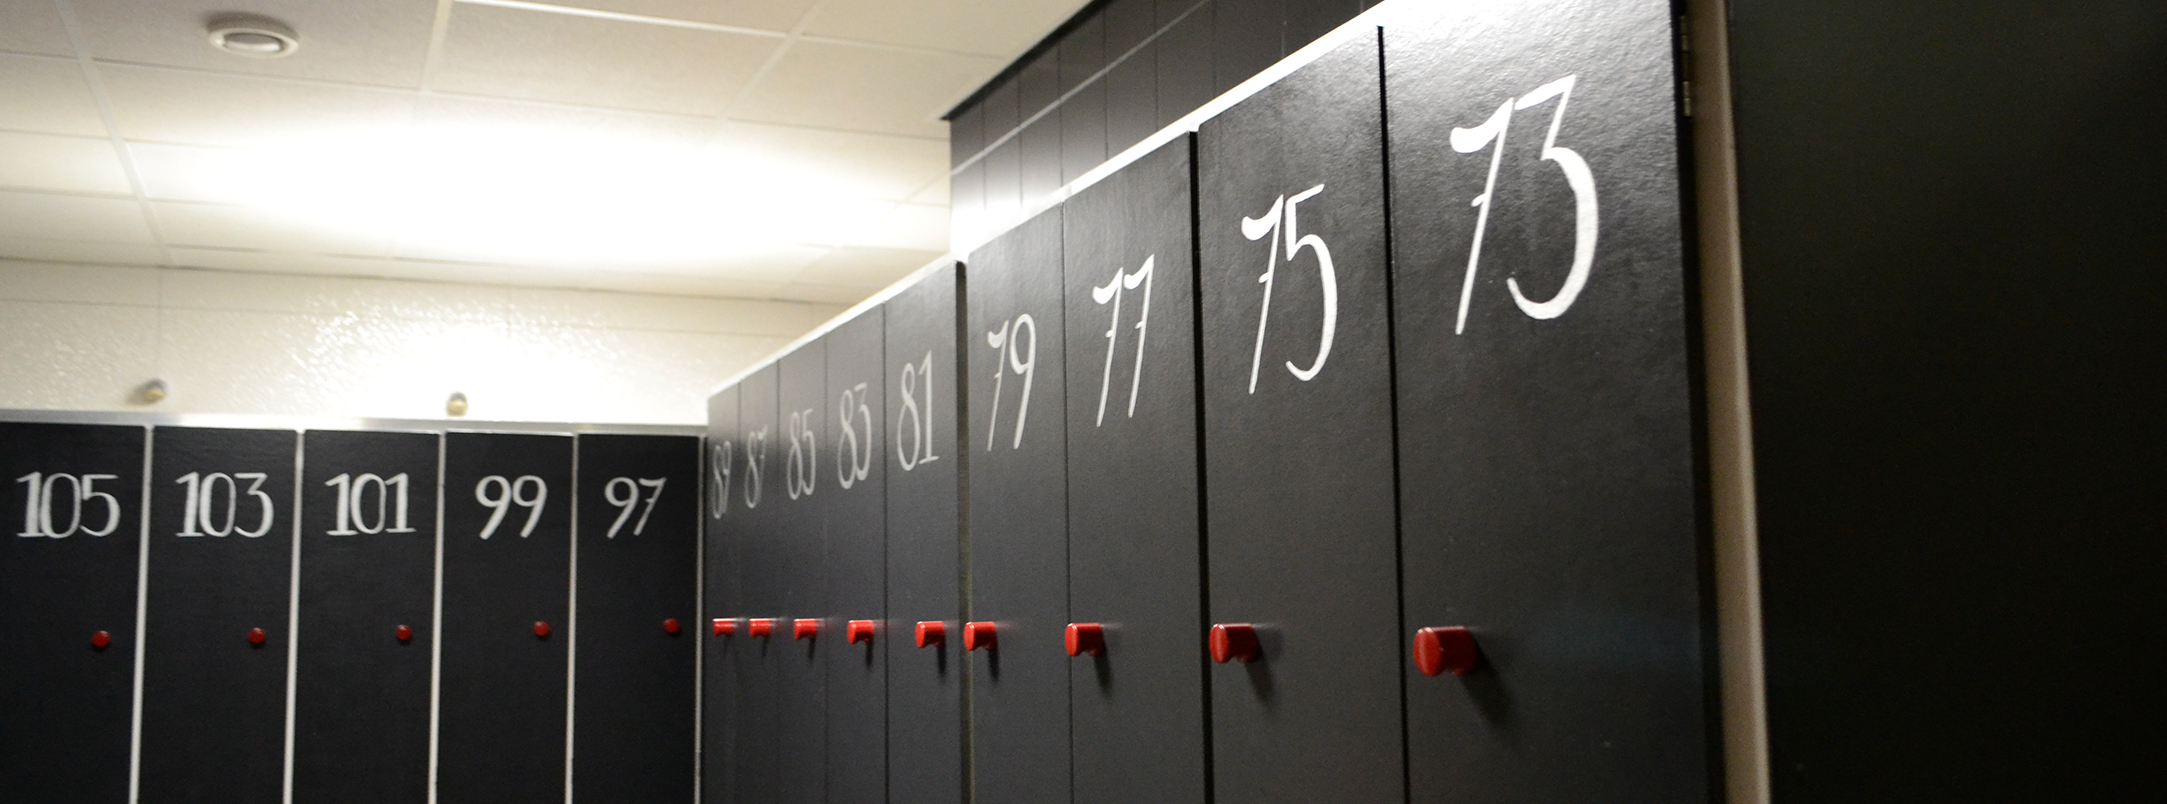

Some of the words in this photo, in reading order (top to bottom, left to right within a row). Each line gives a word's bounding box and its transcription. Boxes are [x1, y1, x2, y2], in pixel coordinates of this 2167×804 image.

[1450, 74, 1599, 335] 73
[1241, 184, 1337, 394] 75
[987, 313, 1036, 451] 79
[1092, 254, 1154, 427] 77
[787, 408, 816, 500] 85
[837, 382, 872, 489] 83
[897, 350, 939, 471] 81
[16, 471, 121, 538] 105
[175, 471, 274, 538] 103
[324, 472, 416, 536] 101
[475, 475, 548, 539] 99
[604, 477, 667, 538] 97
[712, 440, 732, 519] 89
[745, 424, 768, 508] 87
